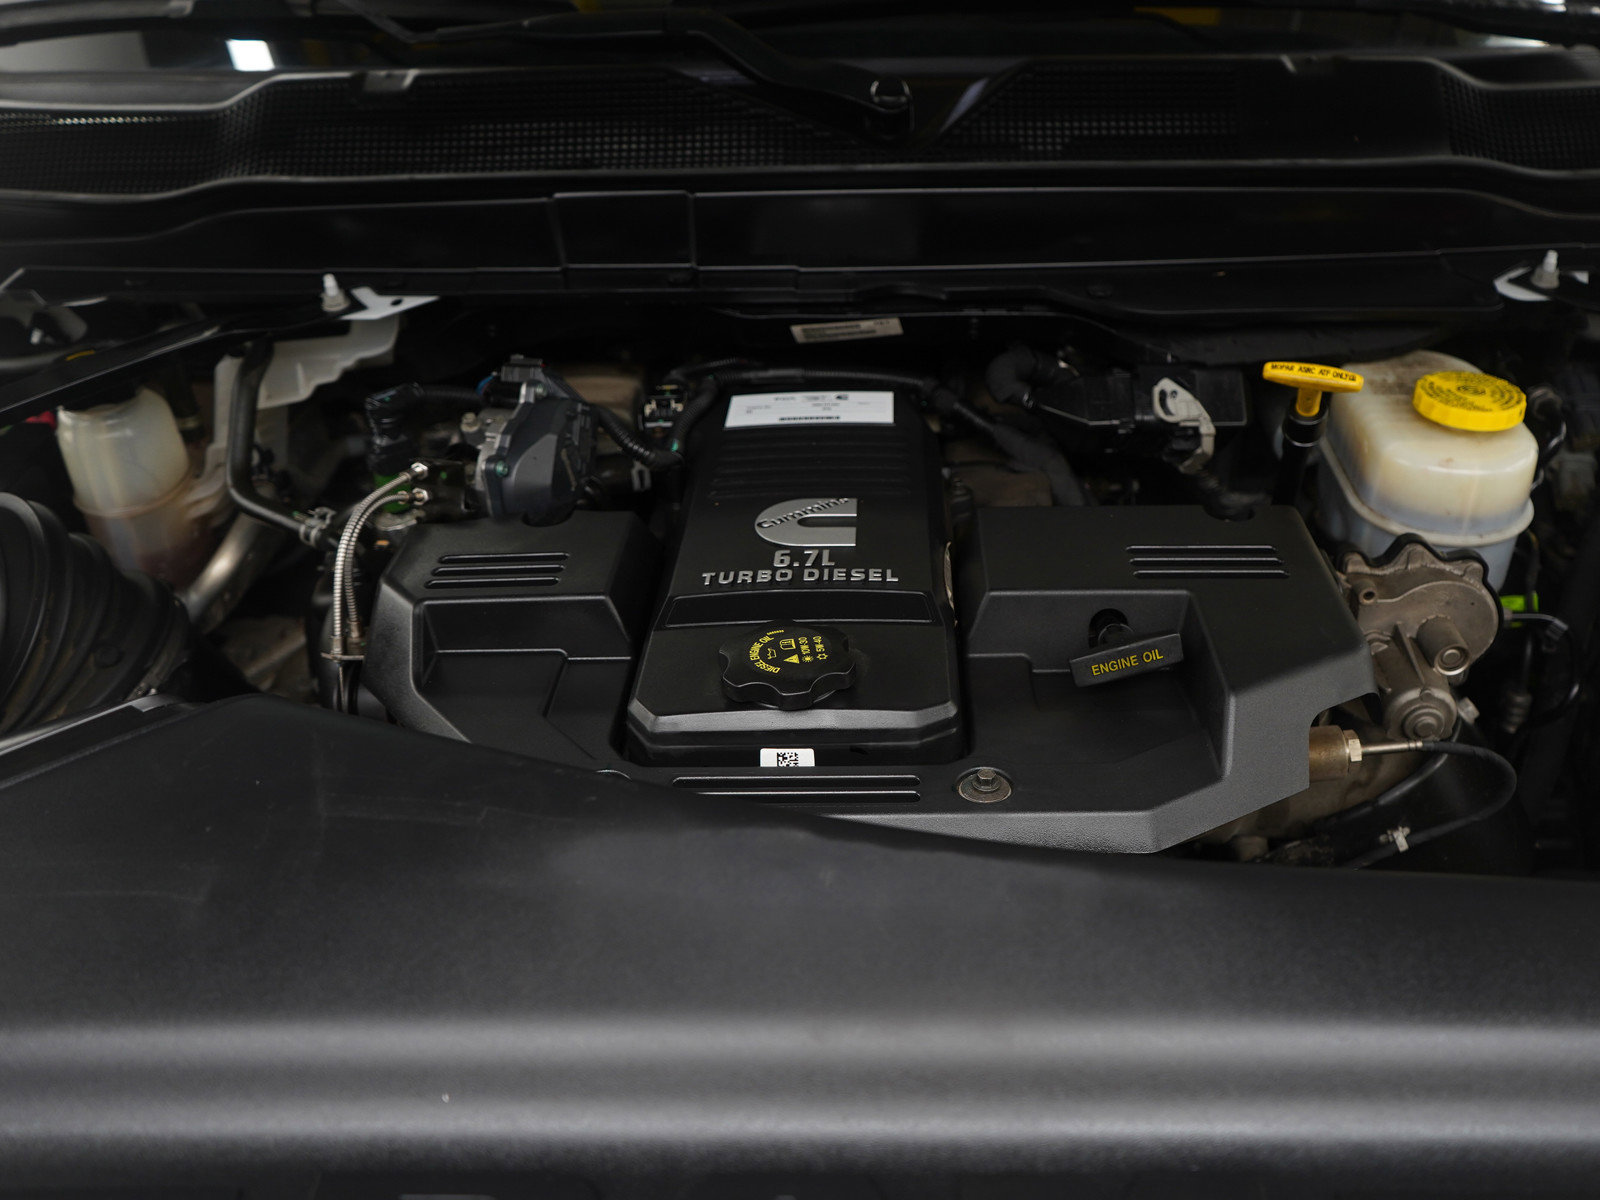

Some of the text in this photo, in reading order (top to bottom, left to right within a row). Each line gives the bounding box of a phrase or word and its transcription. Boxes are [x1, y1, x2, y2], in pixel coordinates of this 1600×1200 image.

[1271, 363, 1294, 371] MOPAR
[1319, 368, 1331, 376] ATF
[1333, 371, 1348, 379] ONLY
[756, 498, 848, 528] Cummins
[773, 550, 836, 567] 6.7L
[702, 568, 899, 585] TURBO DIESEL
[749, 641, 763, 660] ENGINE
[798, 636, 811, 655] 10W-30
[813, 635, 825, 652] 5W-40
[754, 660, 780, 673] DIESEL
[1091, 649, 1164, 676] ENGINE OIL
